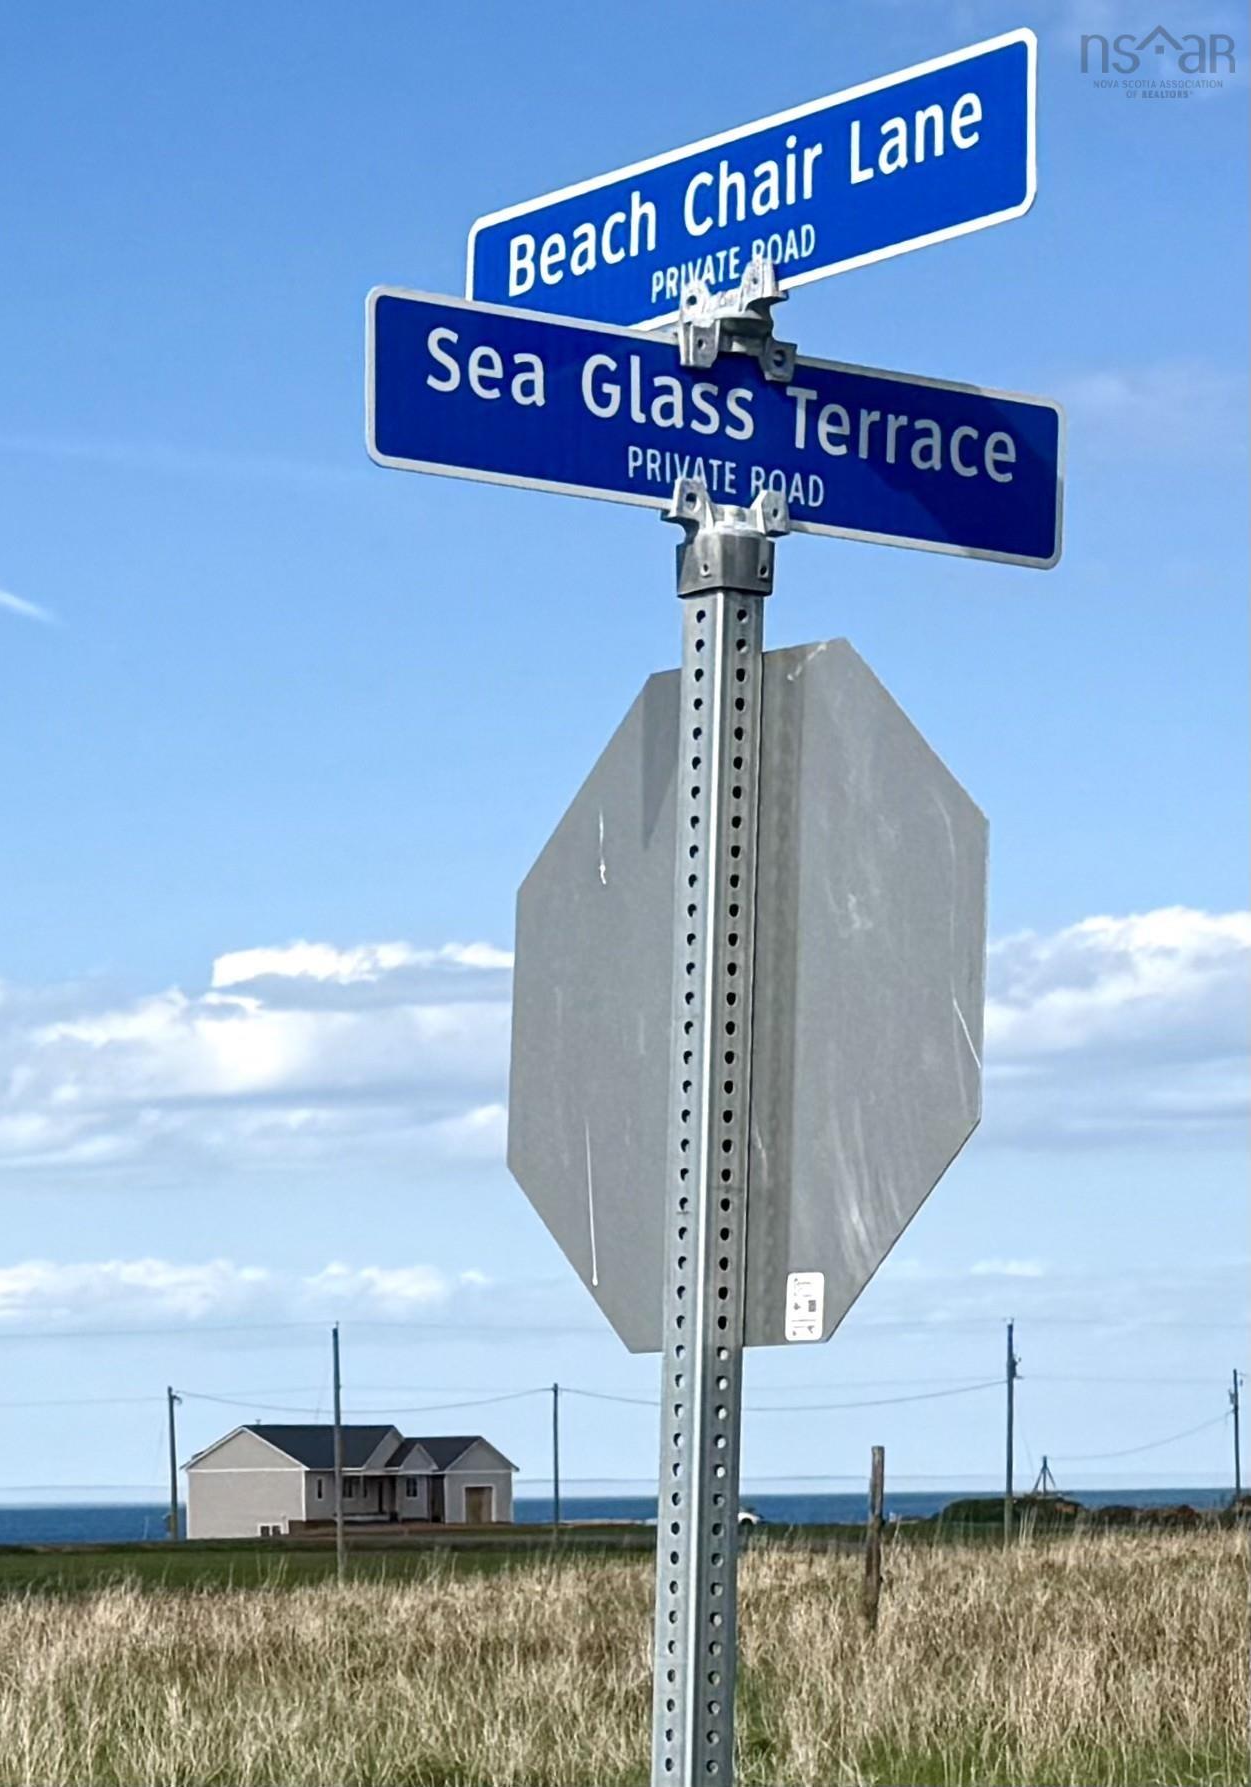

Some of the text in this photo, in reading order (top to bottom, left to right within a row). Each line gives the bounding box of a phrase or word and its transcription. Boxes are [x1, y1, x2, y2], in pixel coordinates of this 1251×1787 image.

[508, 92, 983, 298] Beach Chair Lane
[651, 223, 816, 304] PRIVATE ROAD
[425, 326, 1017, 483] Sea Glass Terrace
[628, 445, 825, 508] PRIVATE ROAD
